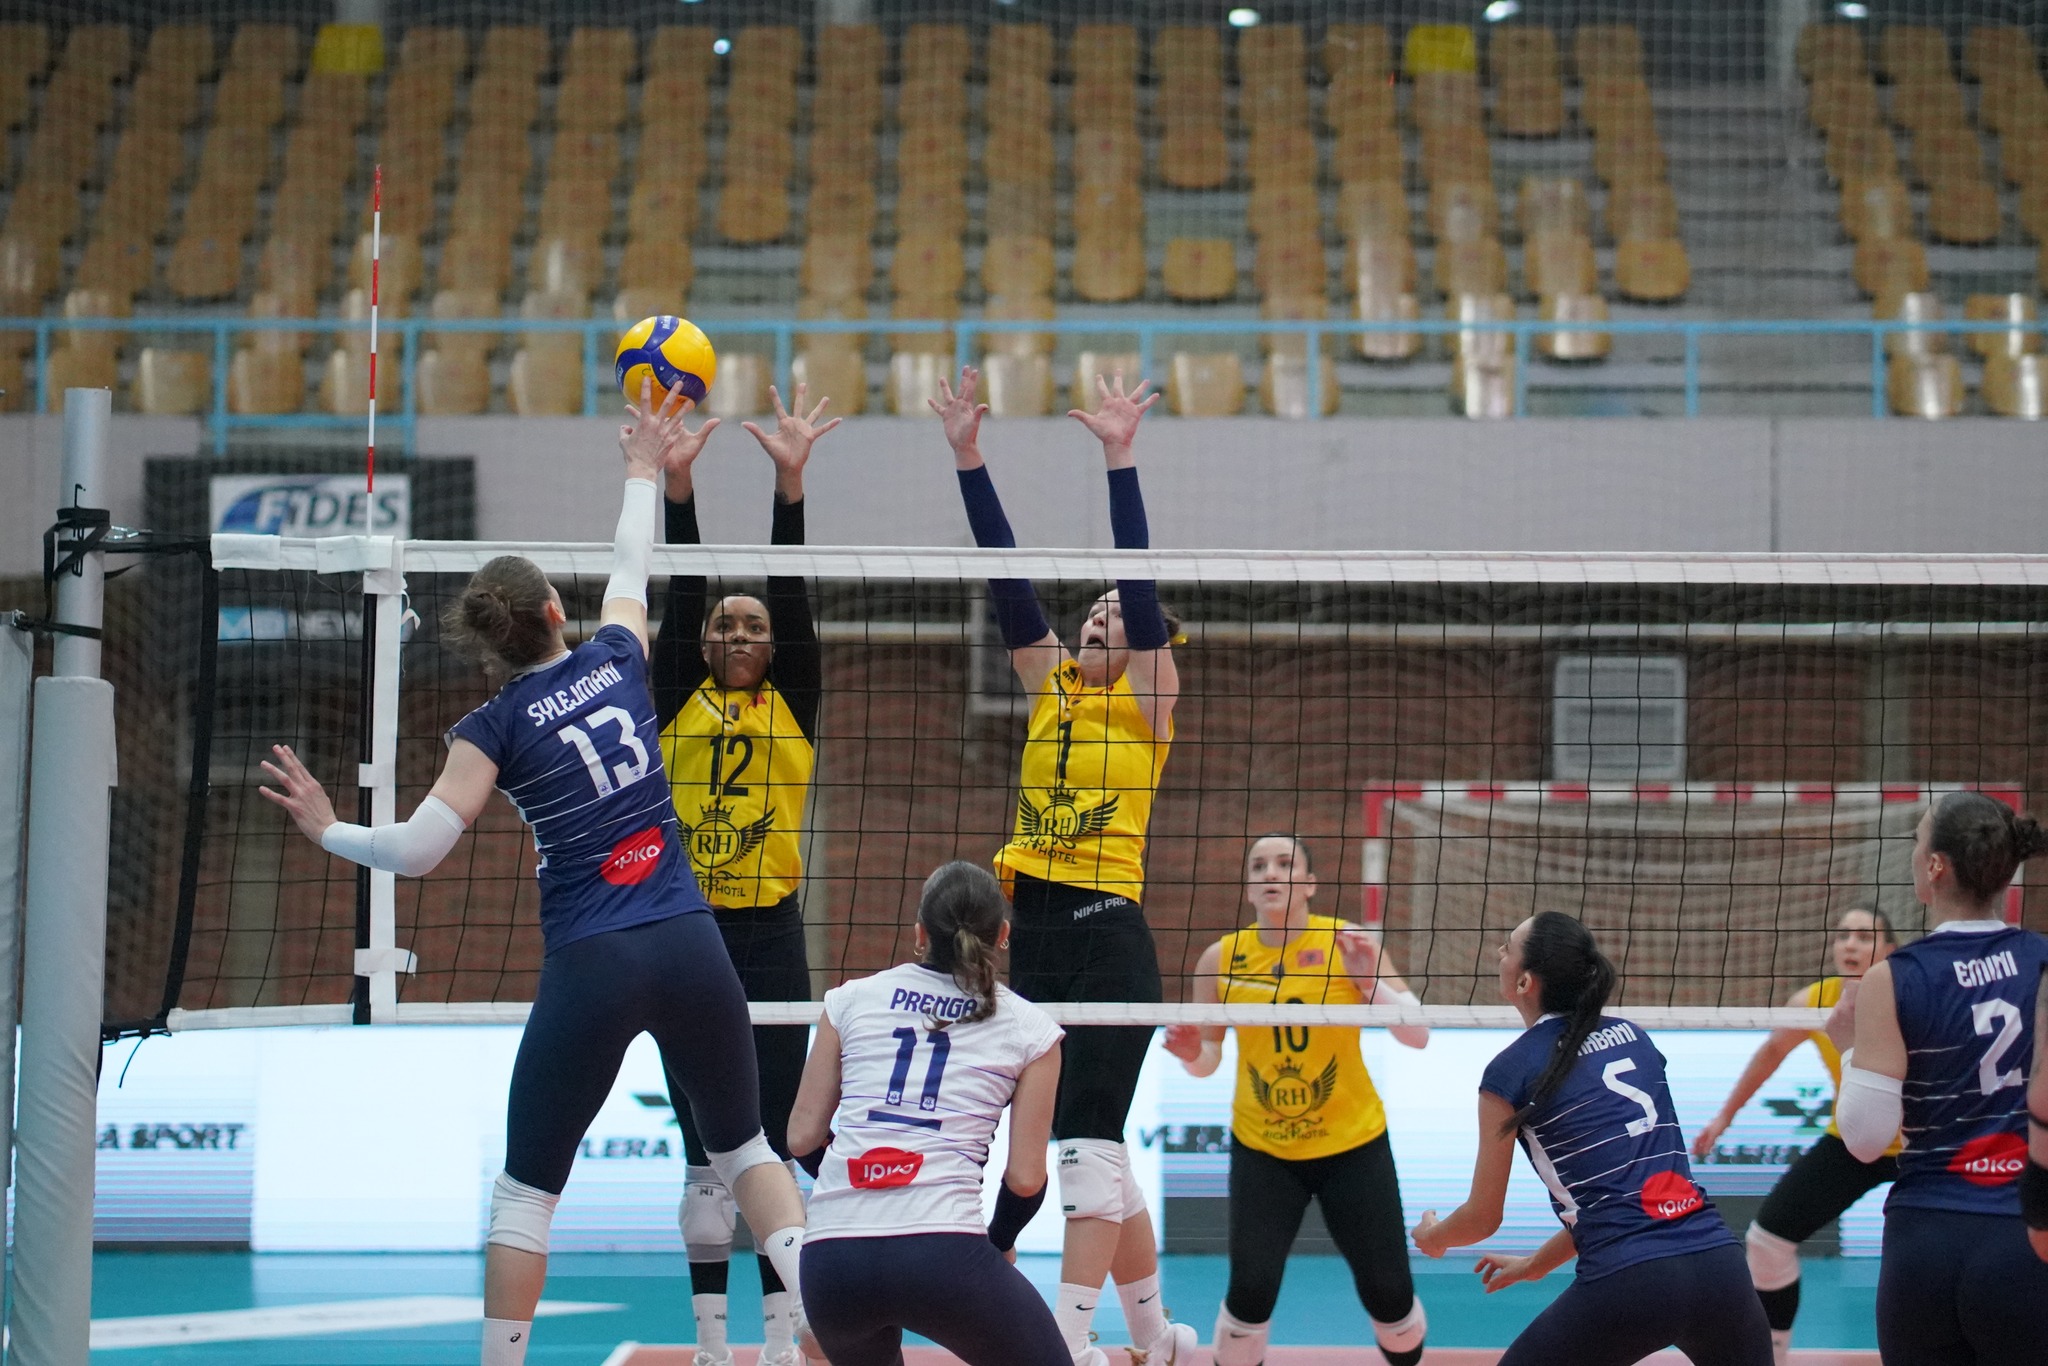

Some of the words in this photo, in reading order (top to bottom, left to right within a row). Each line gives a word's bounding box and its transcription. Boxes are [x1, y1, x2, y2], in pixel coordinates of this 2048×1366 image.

[256, 488, 401, 528] FIDES
[527, 660, 623, 728] SYLEJMANI
[557, 705, 650, 798] 13
[709, 733, 754, 797] 12
[1058, 720, 1073, 780] 1
[696, 834, 733, 854] RH
[1038, 846, 1078, 865] HOTEL
[1073, 901, 1103, 921] NIKE
[1104, 895, 1128, 910] PRO
[1953, 951, 2018, 988] EMINI
[890, 988, 978, 1020] PRENGA
[1269, 997, 1309, 1053] 10
[885, 1027, 951, 1112] 11
[1971, 997, 2023, 1096] 2
[1275, 1088, 1307, 1107] RH
[1601, 1057, 1659, 1138] 5
